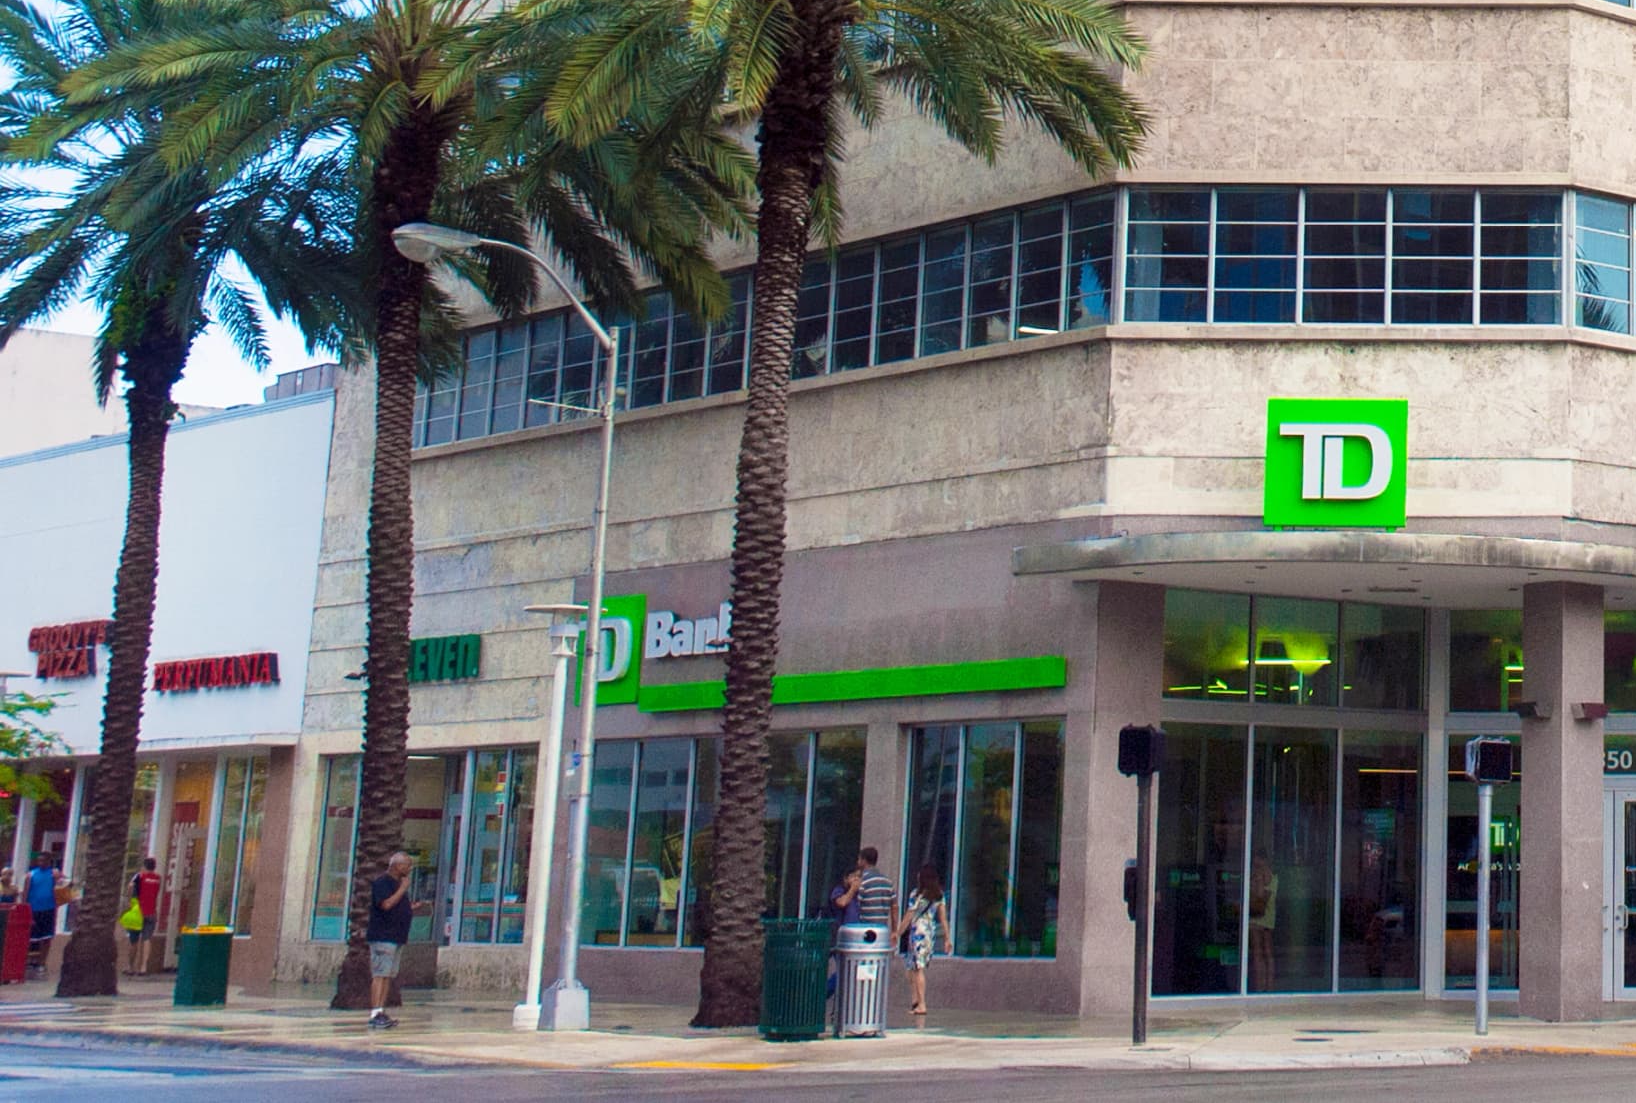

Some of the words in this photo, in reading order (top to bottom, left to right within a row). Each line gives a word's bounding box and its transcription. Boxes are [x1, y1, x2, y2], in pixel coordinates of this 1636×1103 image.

[1279, 423, 1393, 499] TD
[37, 649, 96, 678] PIZZA
[153, 653, 280, 691] PERFUMANIA
